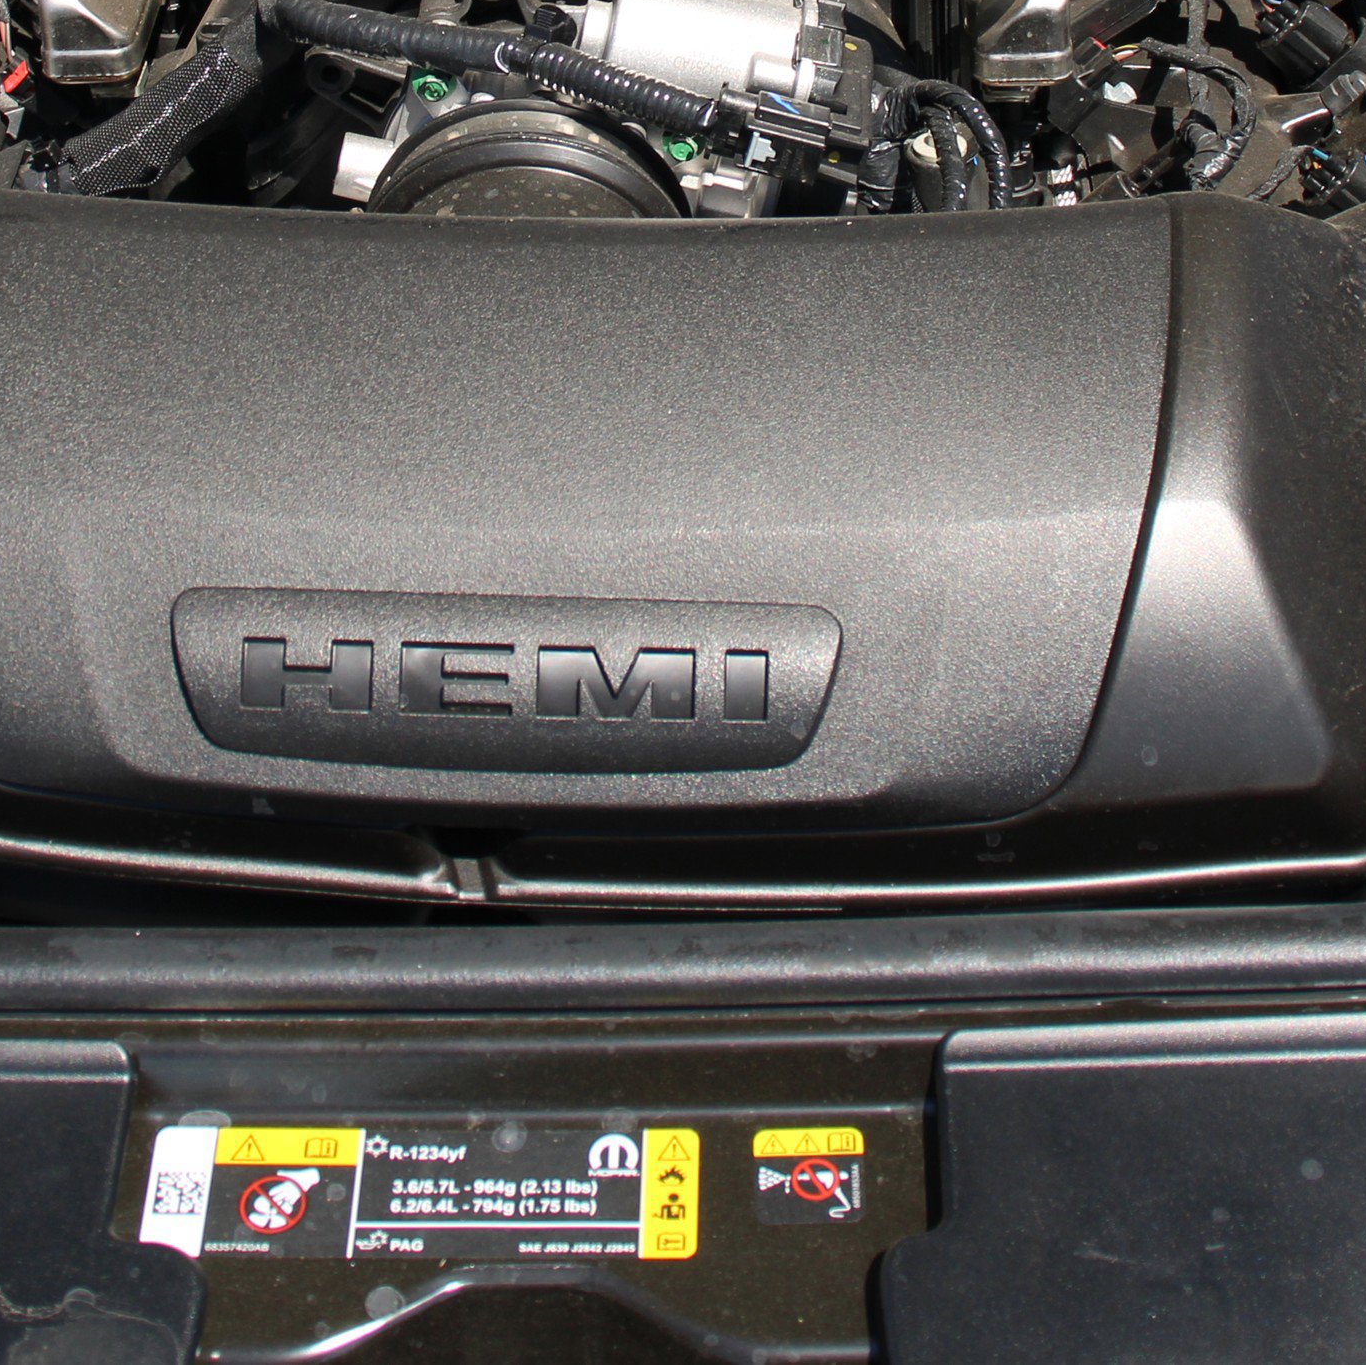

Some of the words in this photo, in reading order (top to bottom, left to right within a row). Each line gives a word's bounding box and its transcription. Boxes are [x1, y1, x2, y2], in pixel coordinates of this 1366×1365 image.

[240, 636, 769, 723] HEMI
[389, 1144, 467, 1164] R-1234yf
[392, 1178, 460, 1195] 3.6/5.7L
[473, 1178, 516, 1197] 964g
[520, 1178, 562, 1197] (2.13
[565, 1178, 598, 1197] lbs)
[390, 1197, 459, 1214] 6.2/6.4L
[472, 1197, 515, 1216] 794g
[518, 1197, 561, 1216] (1.75
[563, 1197, 598, 1216] lbs)
[389, 1238, 424, 1252] PAG
[518, 1242, 542, 1253] SAE
[571, 1242, 603, 1253] J2842
